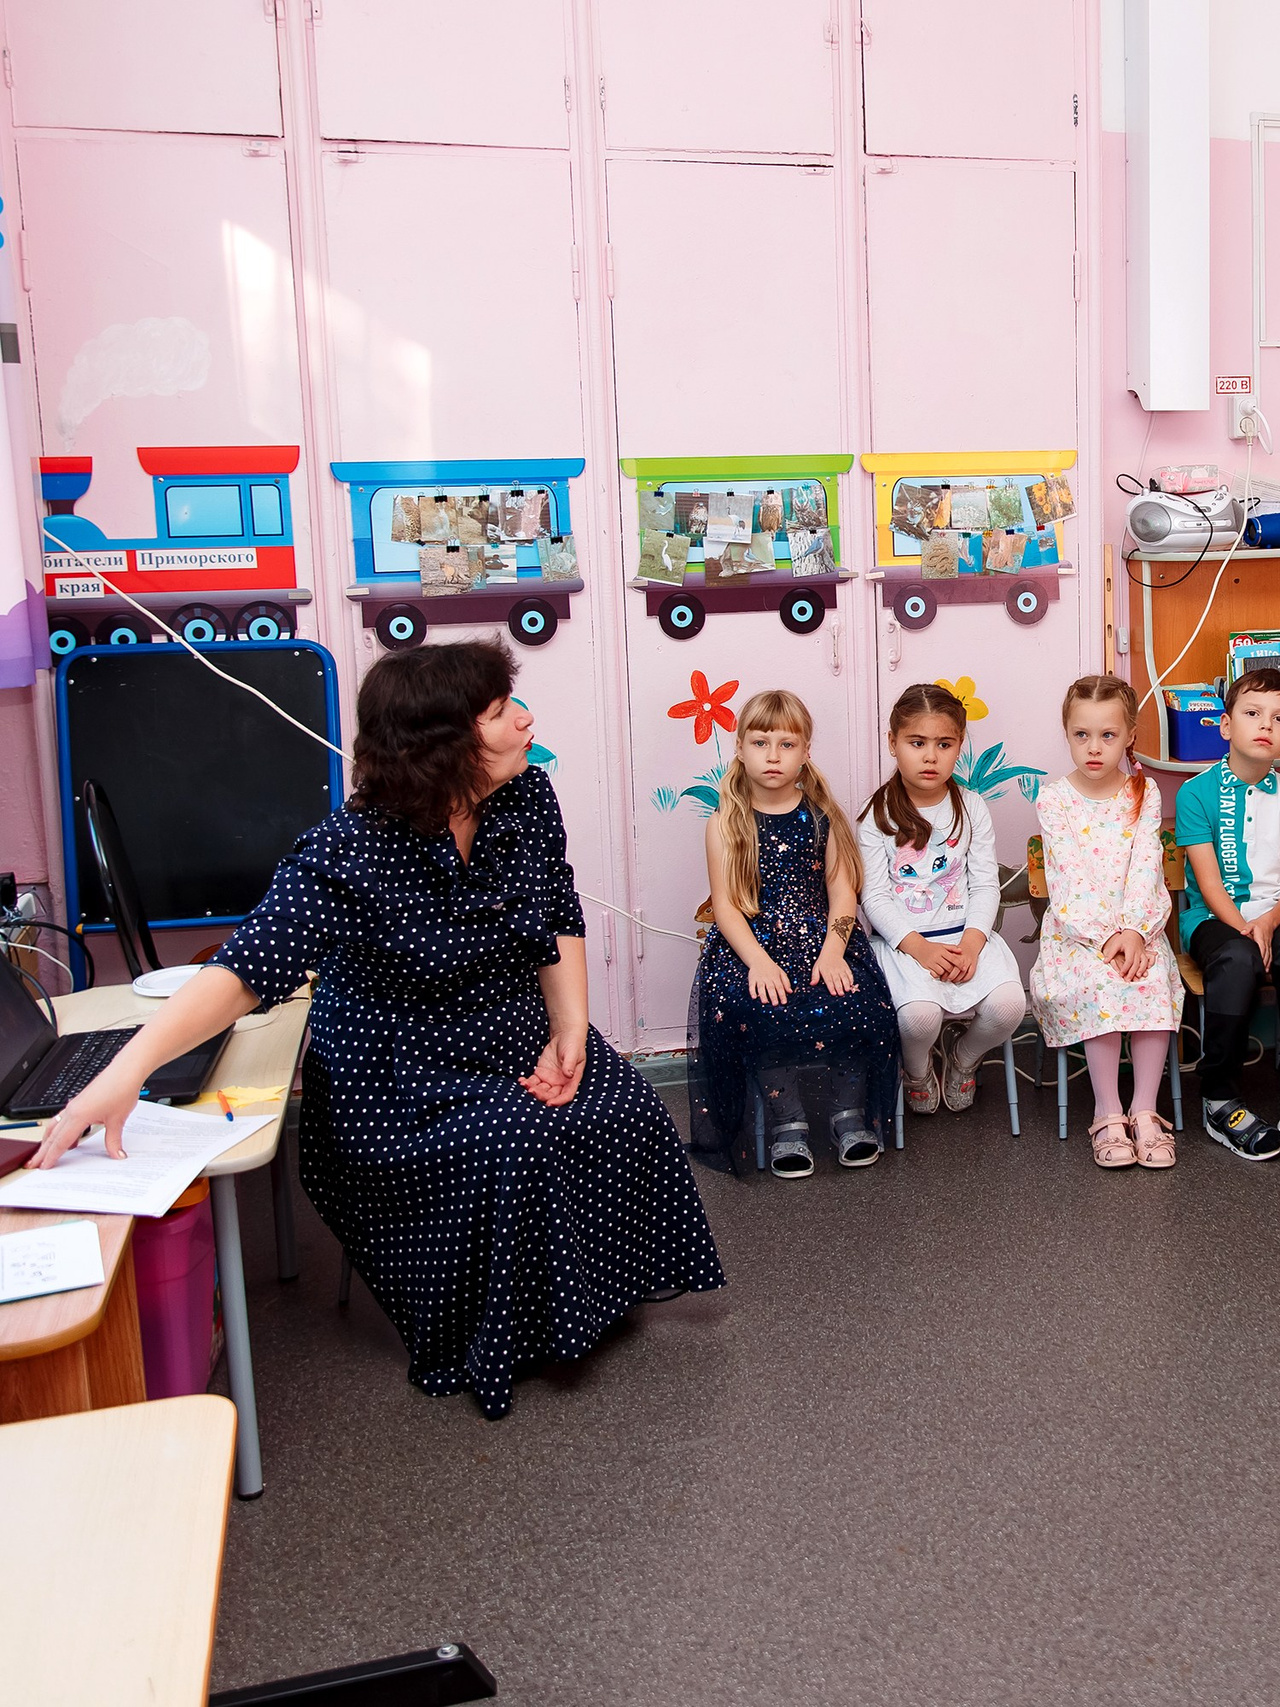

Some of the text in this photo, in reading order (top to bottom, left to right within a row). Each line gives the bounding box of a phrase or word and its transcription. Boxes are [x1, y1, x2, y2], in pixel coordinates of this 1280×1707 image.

[1219, 380, 1238, 390] 220
[44, 552, 254, 569] битатели Приморского
[59, 582, 101, 596] края
[1220, 786, 1236, 816] STAY
[1220, 818, 1239, 873] PLUGGED
